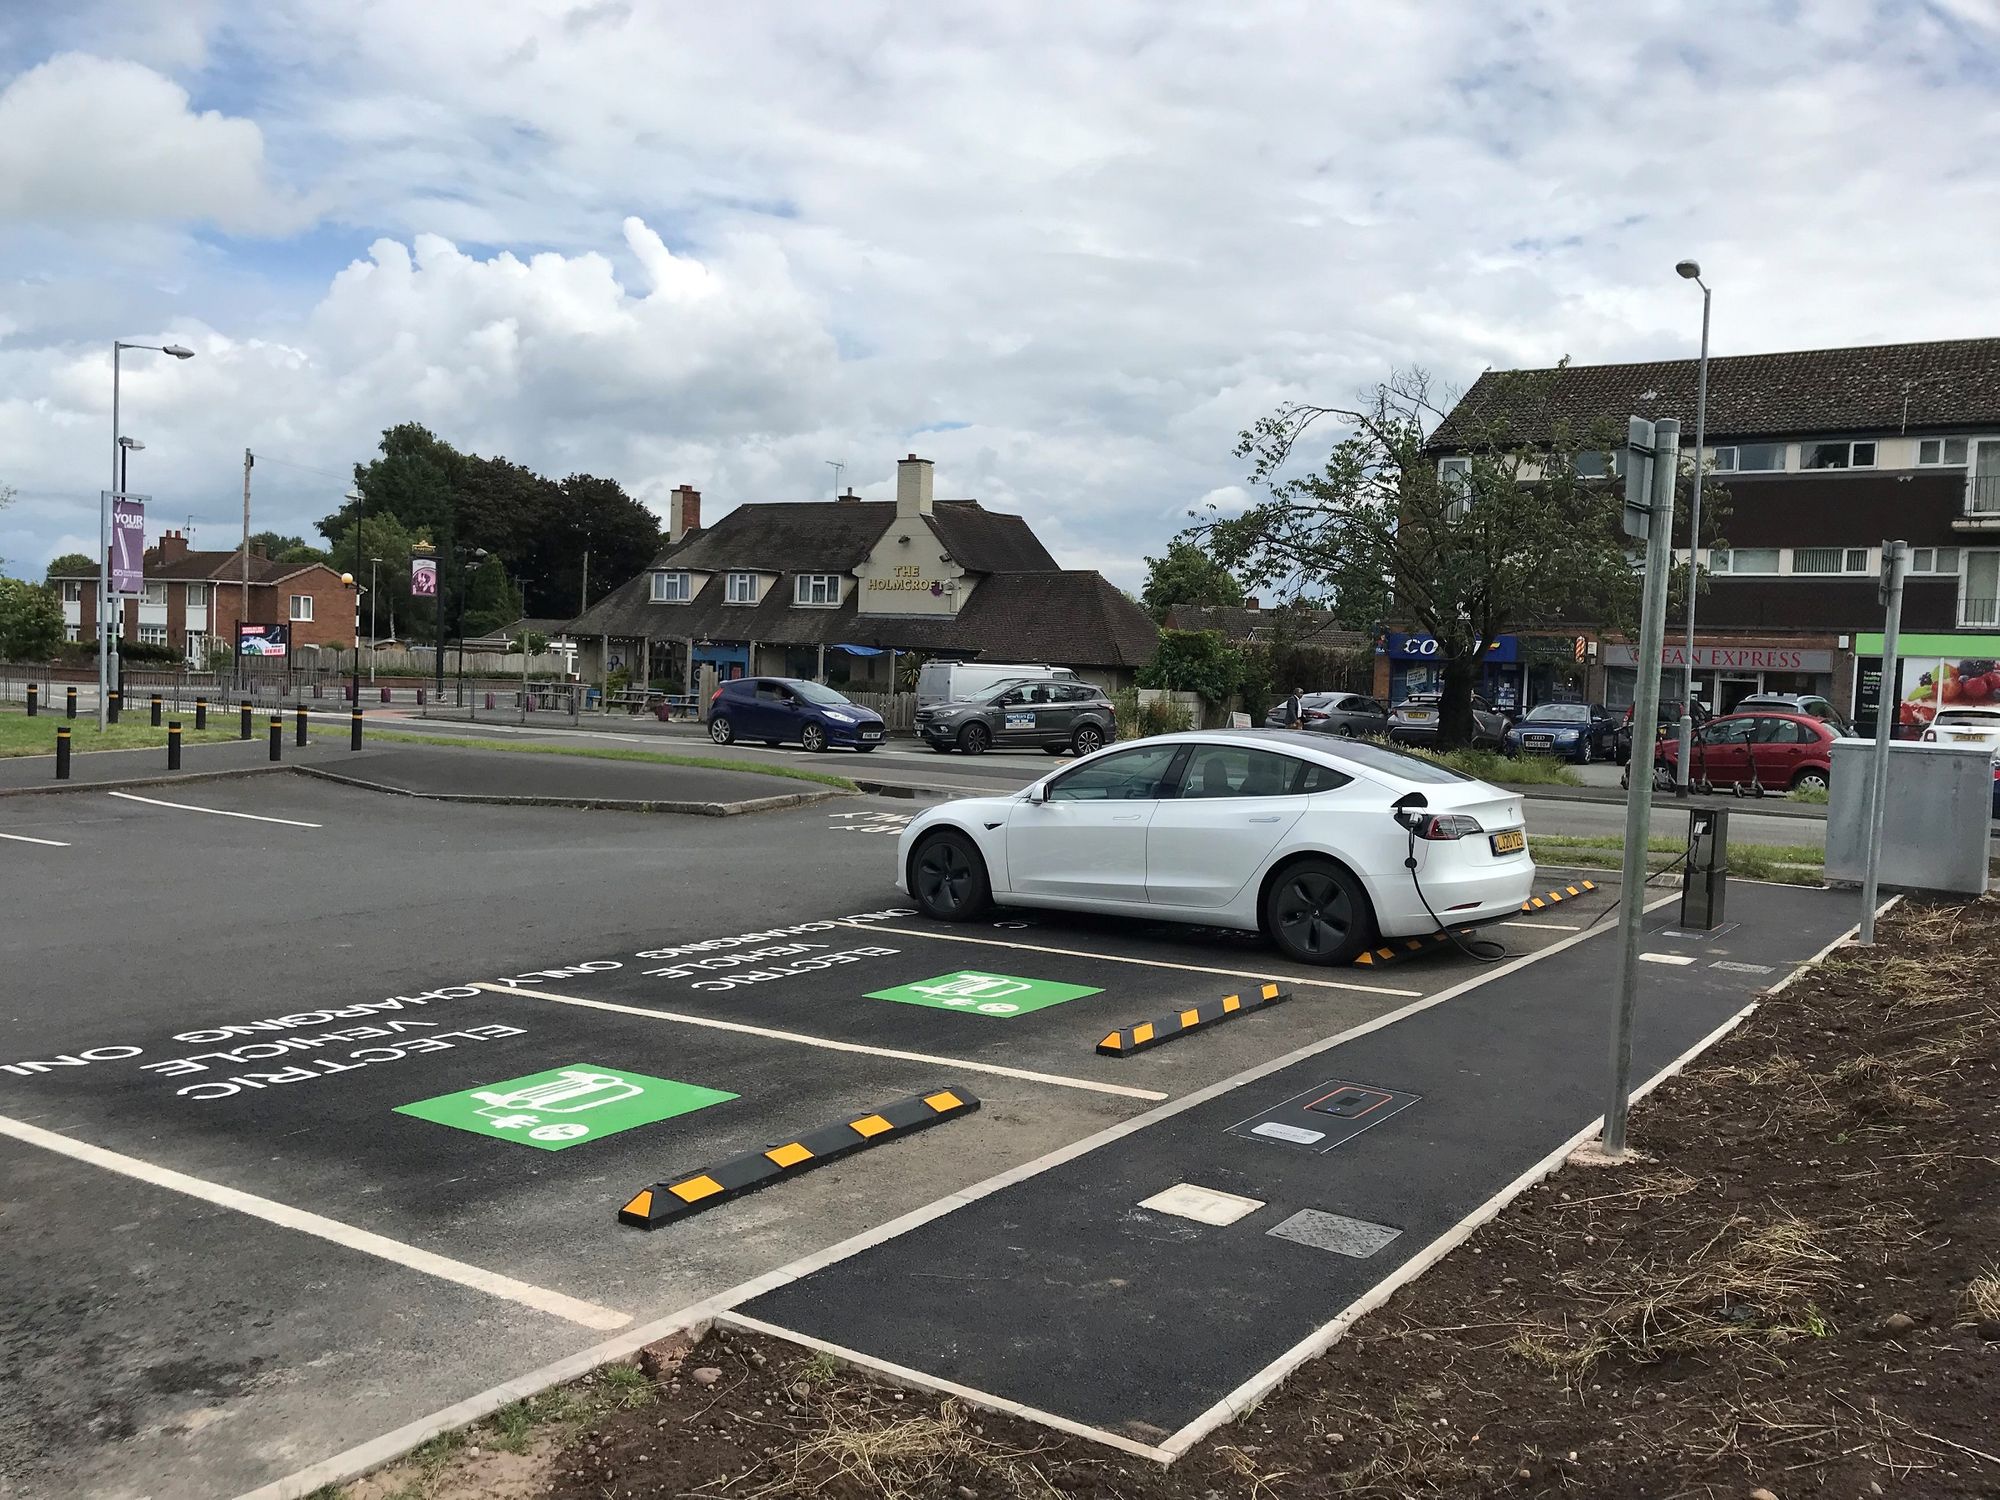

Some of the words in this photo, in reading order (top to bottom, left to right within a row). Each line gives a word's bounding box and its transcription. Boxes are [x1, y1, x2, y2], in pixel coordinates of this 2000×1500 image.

[114, 513, 143, 525] YOUR
[868, 580, 943, 591] HOLMCROFT
[895, 566, 920, 577] THE
[1712, 650, 1801, 668] EXPRESS
[636, 922, 836, 959] CHARGING
[498, 961, 623, 987] ONLY
[642, 943, 829, 978] VEHICLE
[691, 946, 902, 990] ELECTRIC
[172, 986, 481, 1043] CHARGING
[139, 1020, 439, 1077] VEHICLE
[177, 1024, 528, 1100] ELECTRIC
